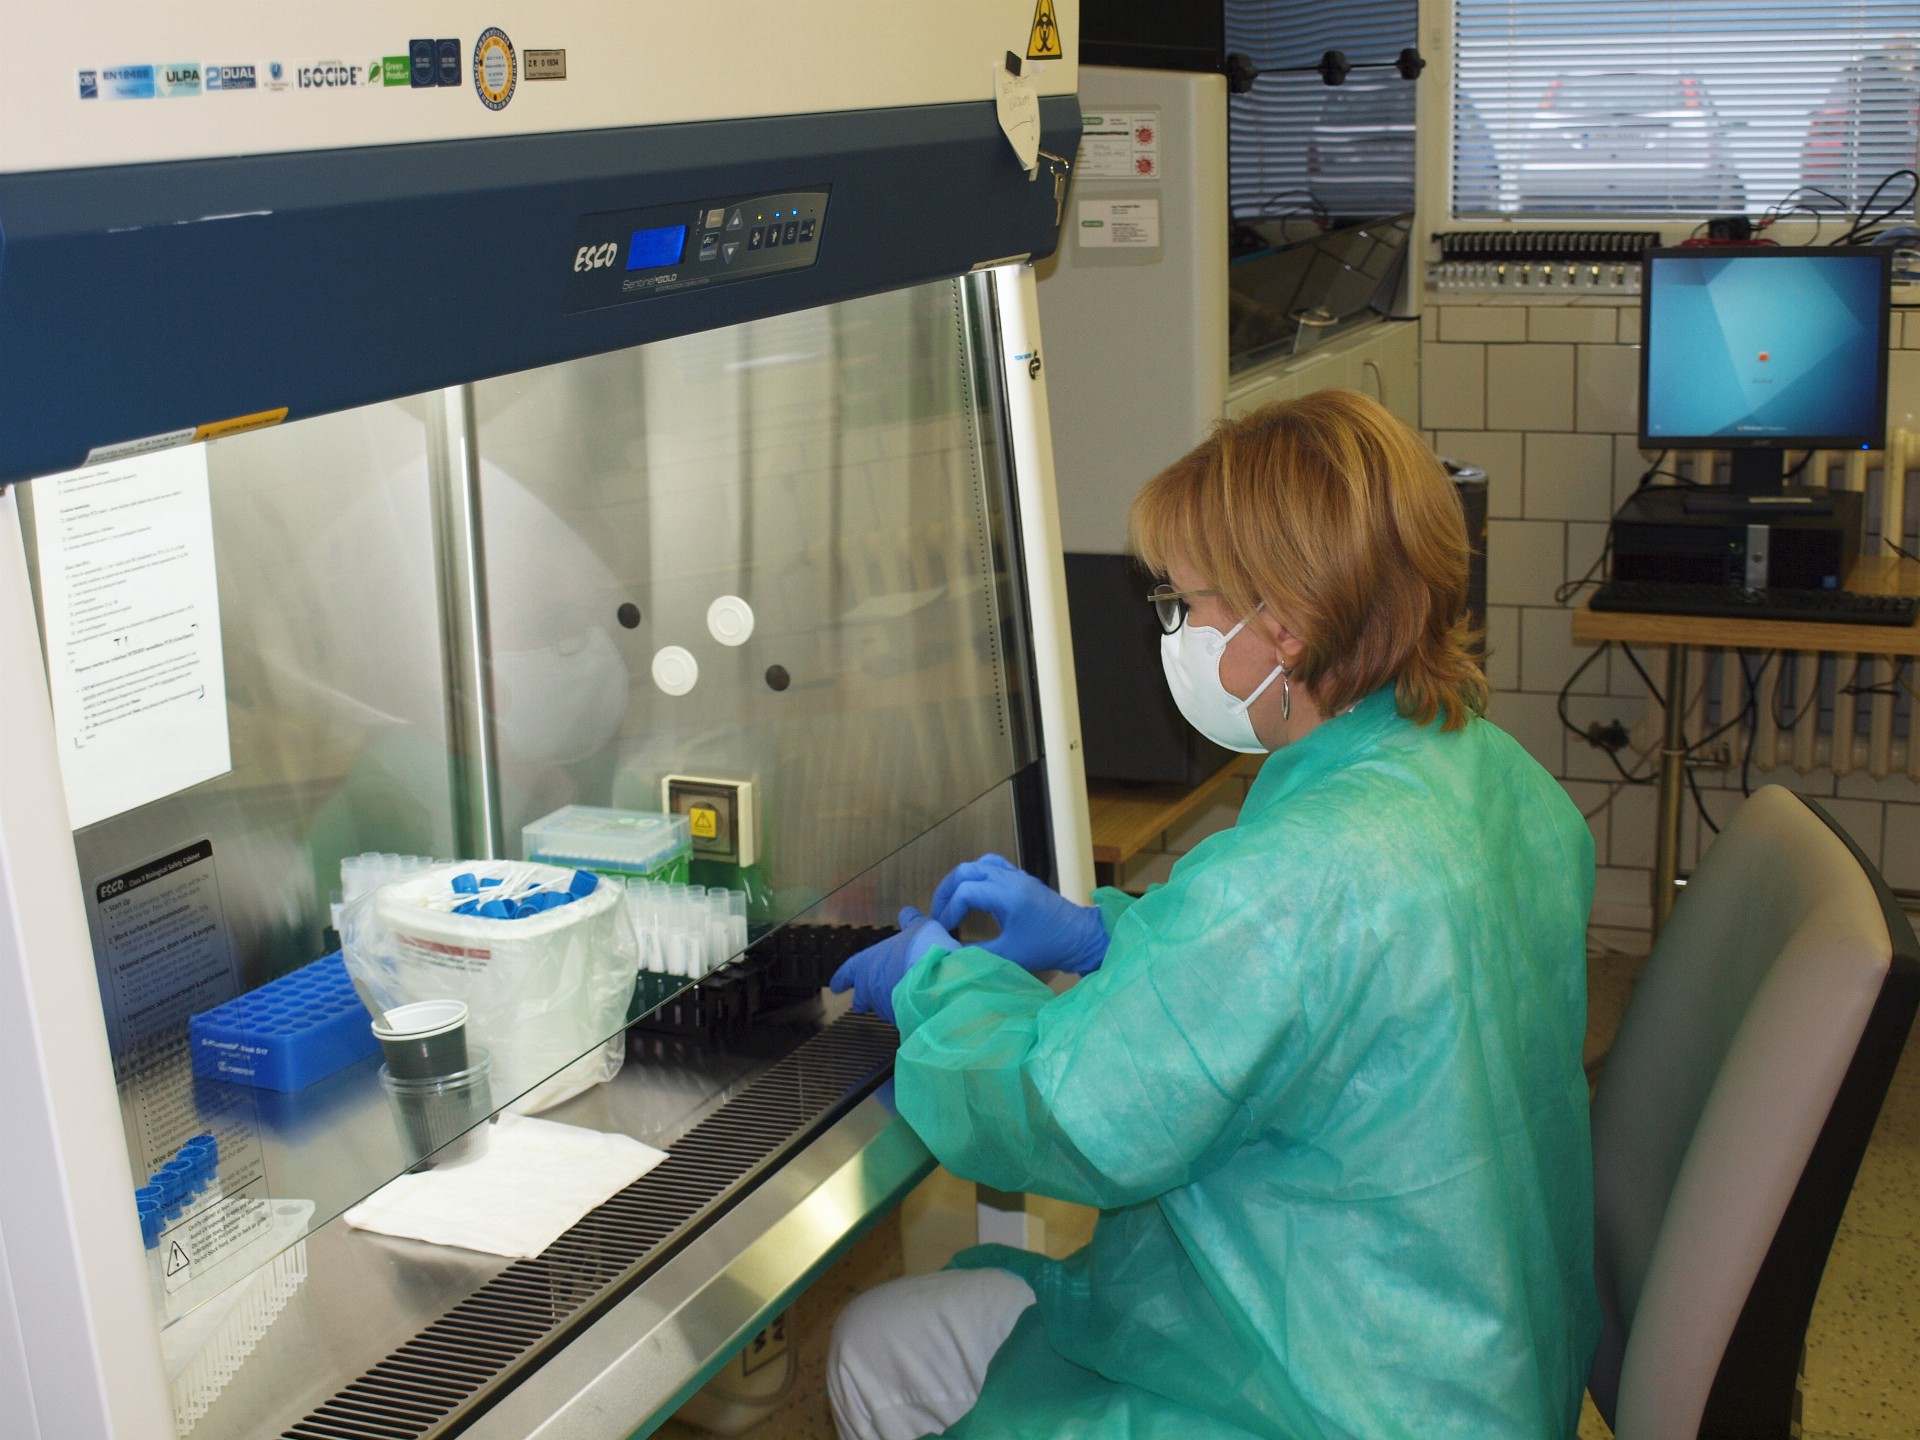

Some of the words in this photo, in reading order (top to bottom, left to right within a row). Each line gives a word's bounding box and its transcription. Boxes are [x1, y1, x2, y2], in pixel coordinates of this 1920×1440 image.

[222, 66, 255, 79] DUAL
[385, 63, 404, 71] Green
[166, 69, 200, 82] ULPA
[386, 71, 409, 80] Product
[574, 242, 618, 273] ESCO
[100, 879, 124, 899] ESCO
